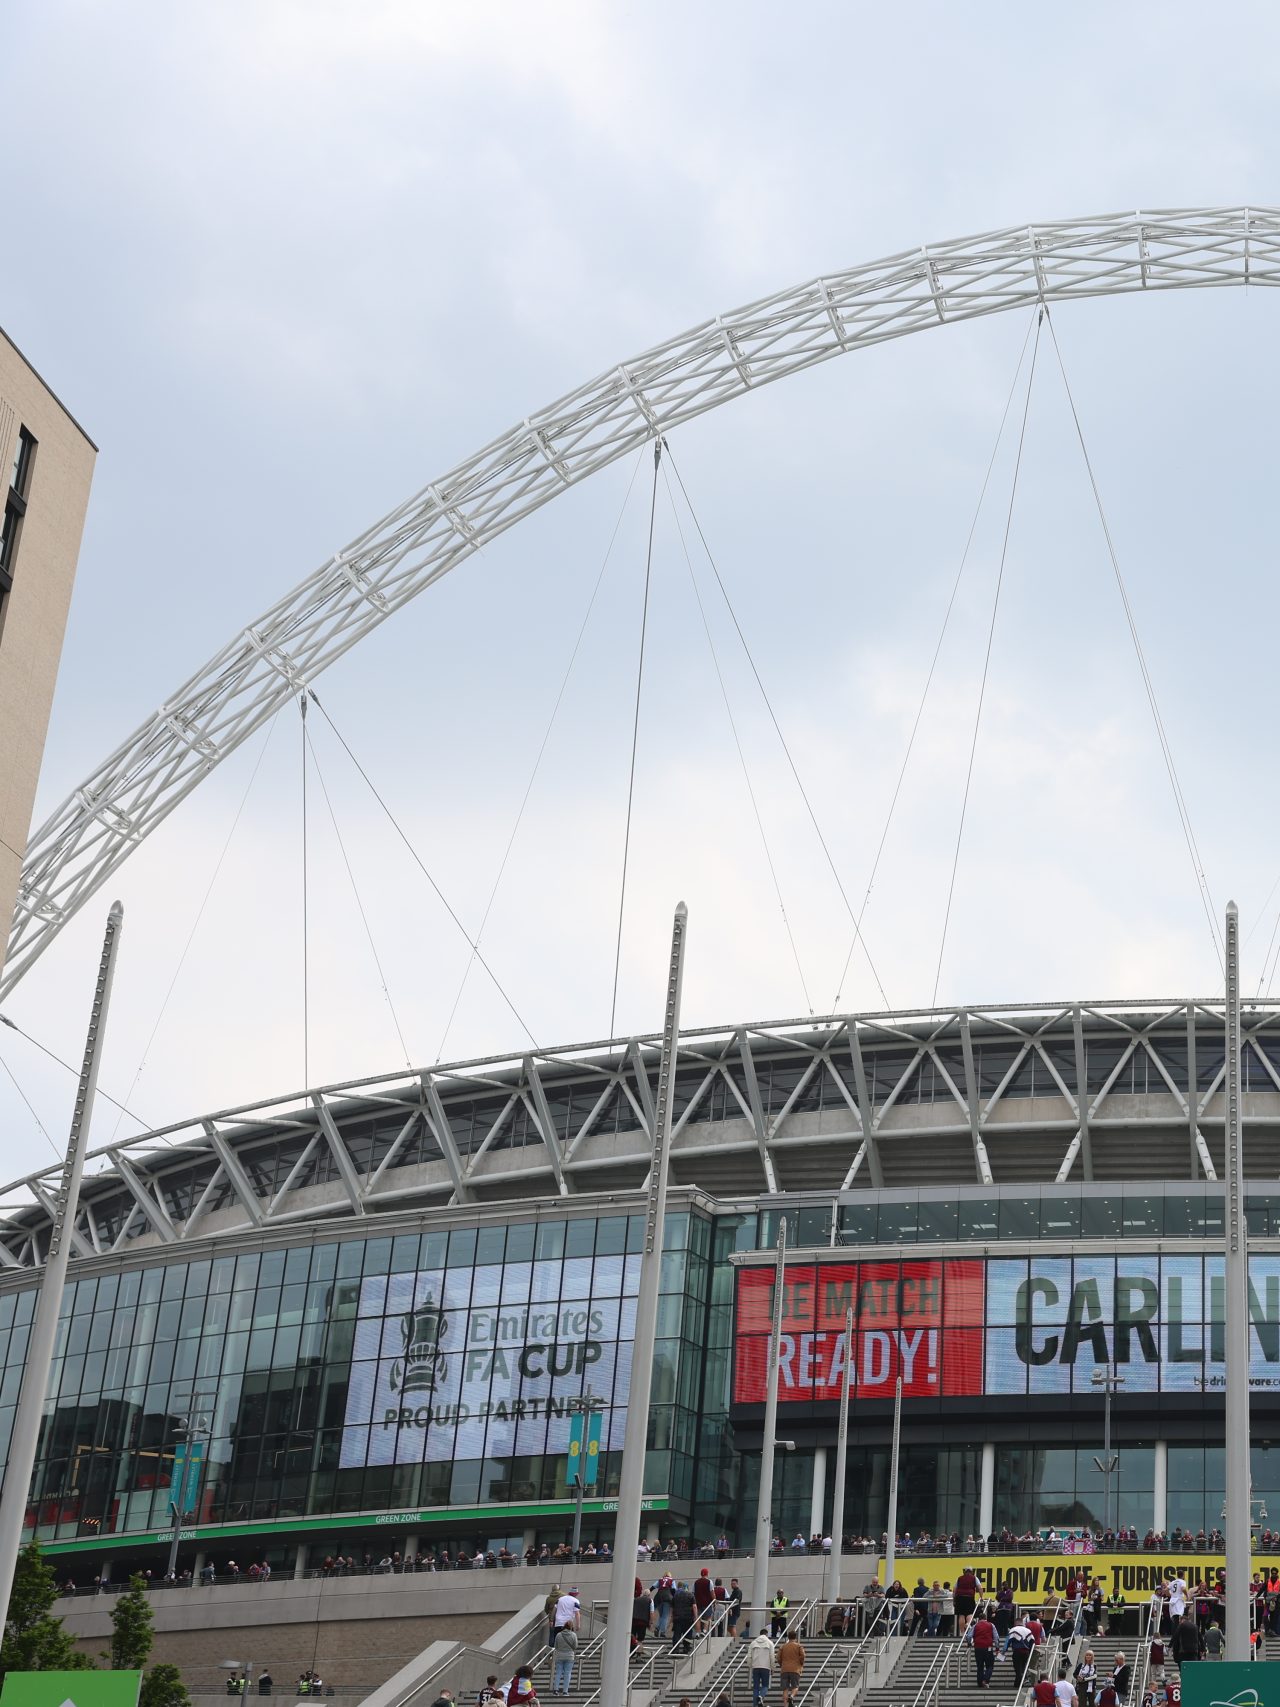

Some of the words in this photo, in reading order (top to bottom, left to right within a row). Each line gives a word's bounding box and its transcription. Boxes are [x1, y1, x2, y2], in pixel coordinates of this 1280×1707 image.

[768, 1281, 811, 1320] BE
[825, 1277, 939, 1317] MATCH
[469, 1308, 604, 1343] Emirates
[465, 1346, 511, 1383] FA
[517, 1340, 603, 1380] CUP
[767, 1329, 939, 1388] READY!
[383, 1403, 470, 1431] PROUD
[477, 1396, 598, 1424] PARTNE
[375, 1514, 400, 1524] GREEN
[400, 1512, 422, 1523] ZONE
[603, 1502, 620, 1511] GRE
[157, 1532, 175, 1542] GREE
[180, 1530, 198, 1540] ZONE
[1172, 1583, 1178, 1594] 9
[1172, 1688, 1181, 1702] 8
